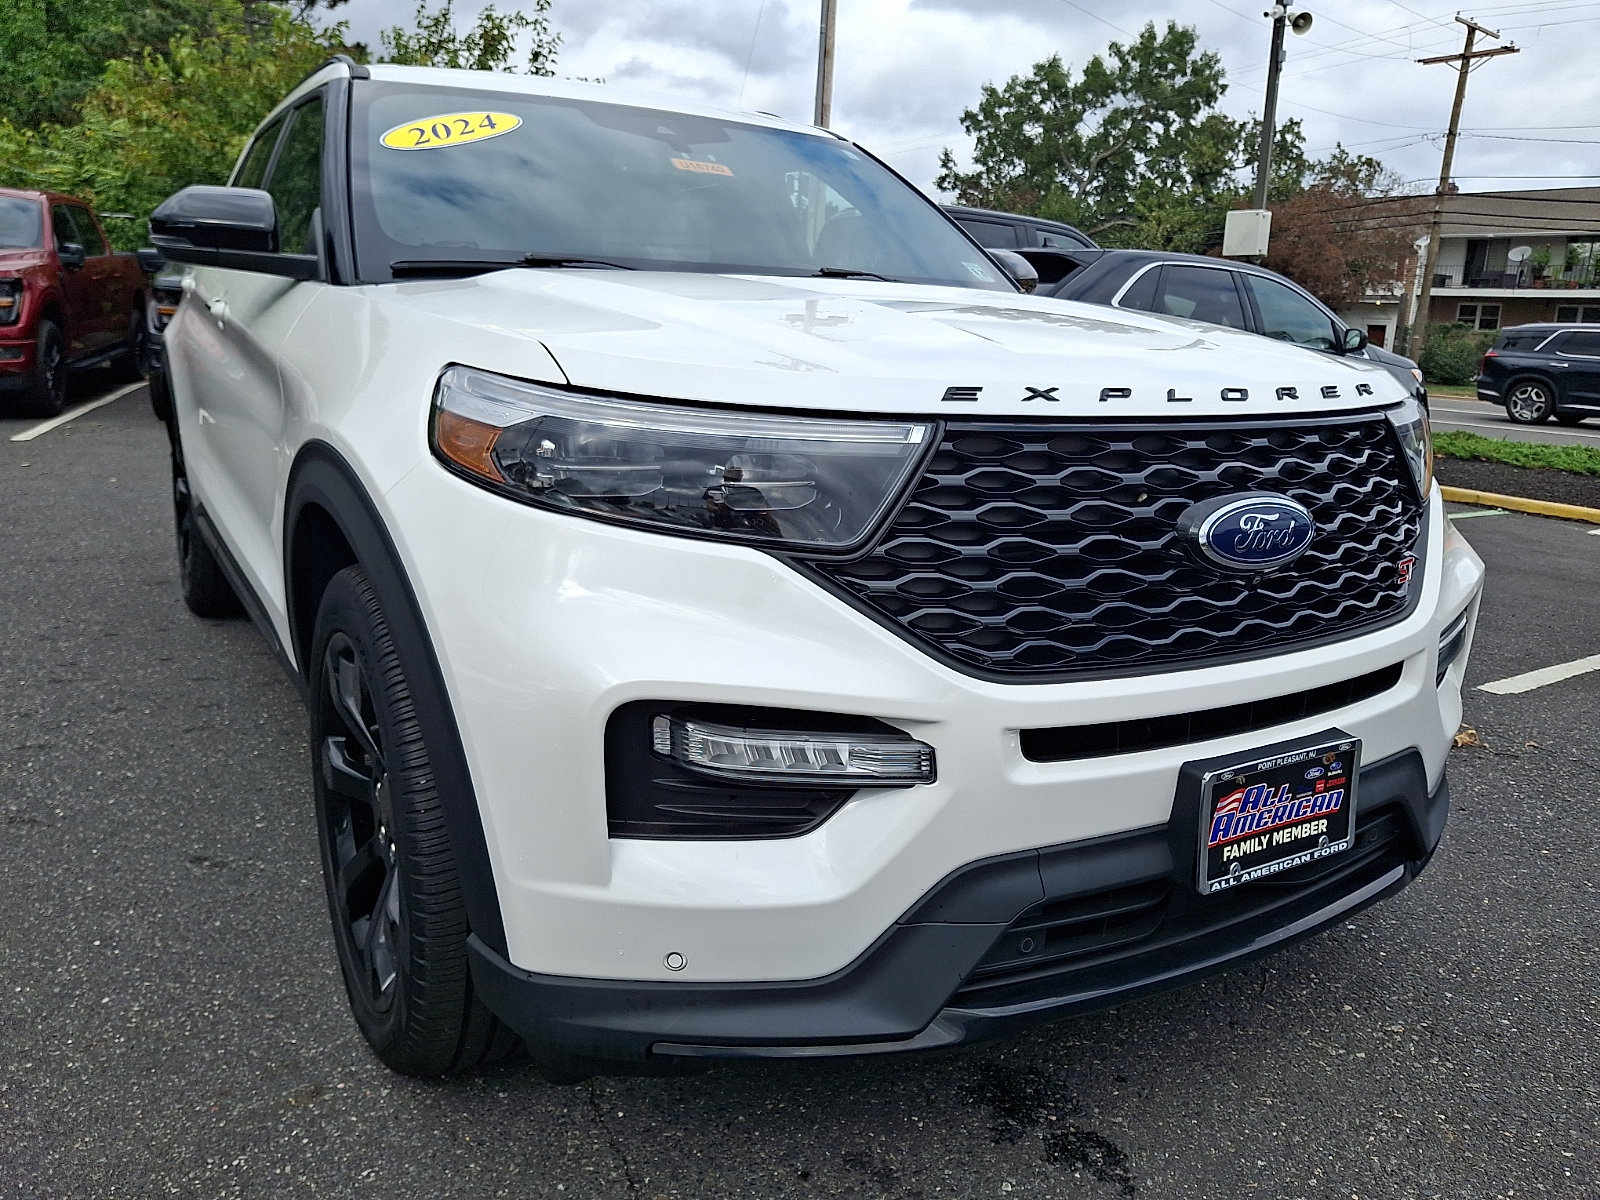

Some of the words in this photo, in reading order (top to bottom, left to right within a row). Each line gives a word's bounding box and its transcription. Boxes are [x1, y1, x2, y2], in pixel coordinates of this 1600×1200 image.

[407, 114, 497, 146] 2024
[941, 383, 1375, 403] EXPLORER
[1235, 512, 1296, 553] Ford
[1257, 758, 1277, 771] POINT
[1276, 752, 1308, 767] PLEASANT,
[1308, 750, 1317, 758] NJ
[1223, 834, 1271, 861] FAMILY
[1272, 819, 1328, 846] MEMBER
[1210, 878, 1238, 892] ALL
[1241, 854, 1311, 882] AMERICAN
[1314, 842, 1348, 859] FORD
